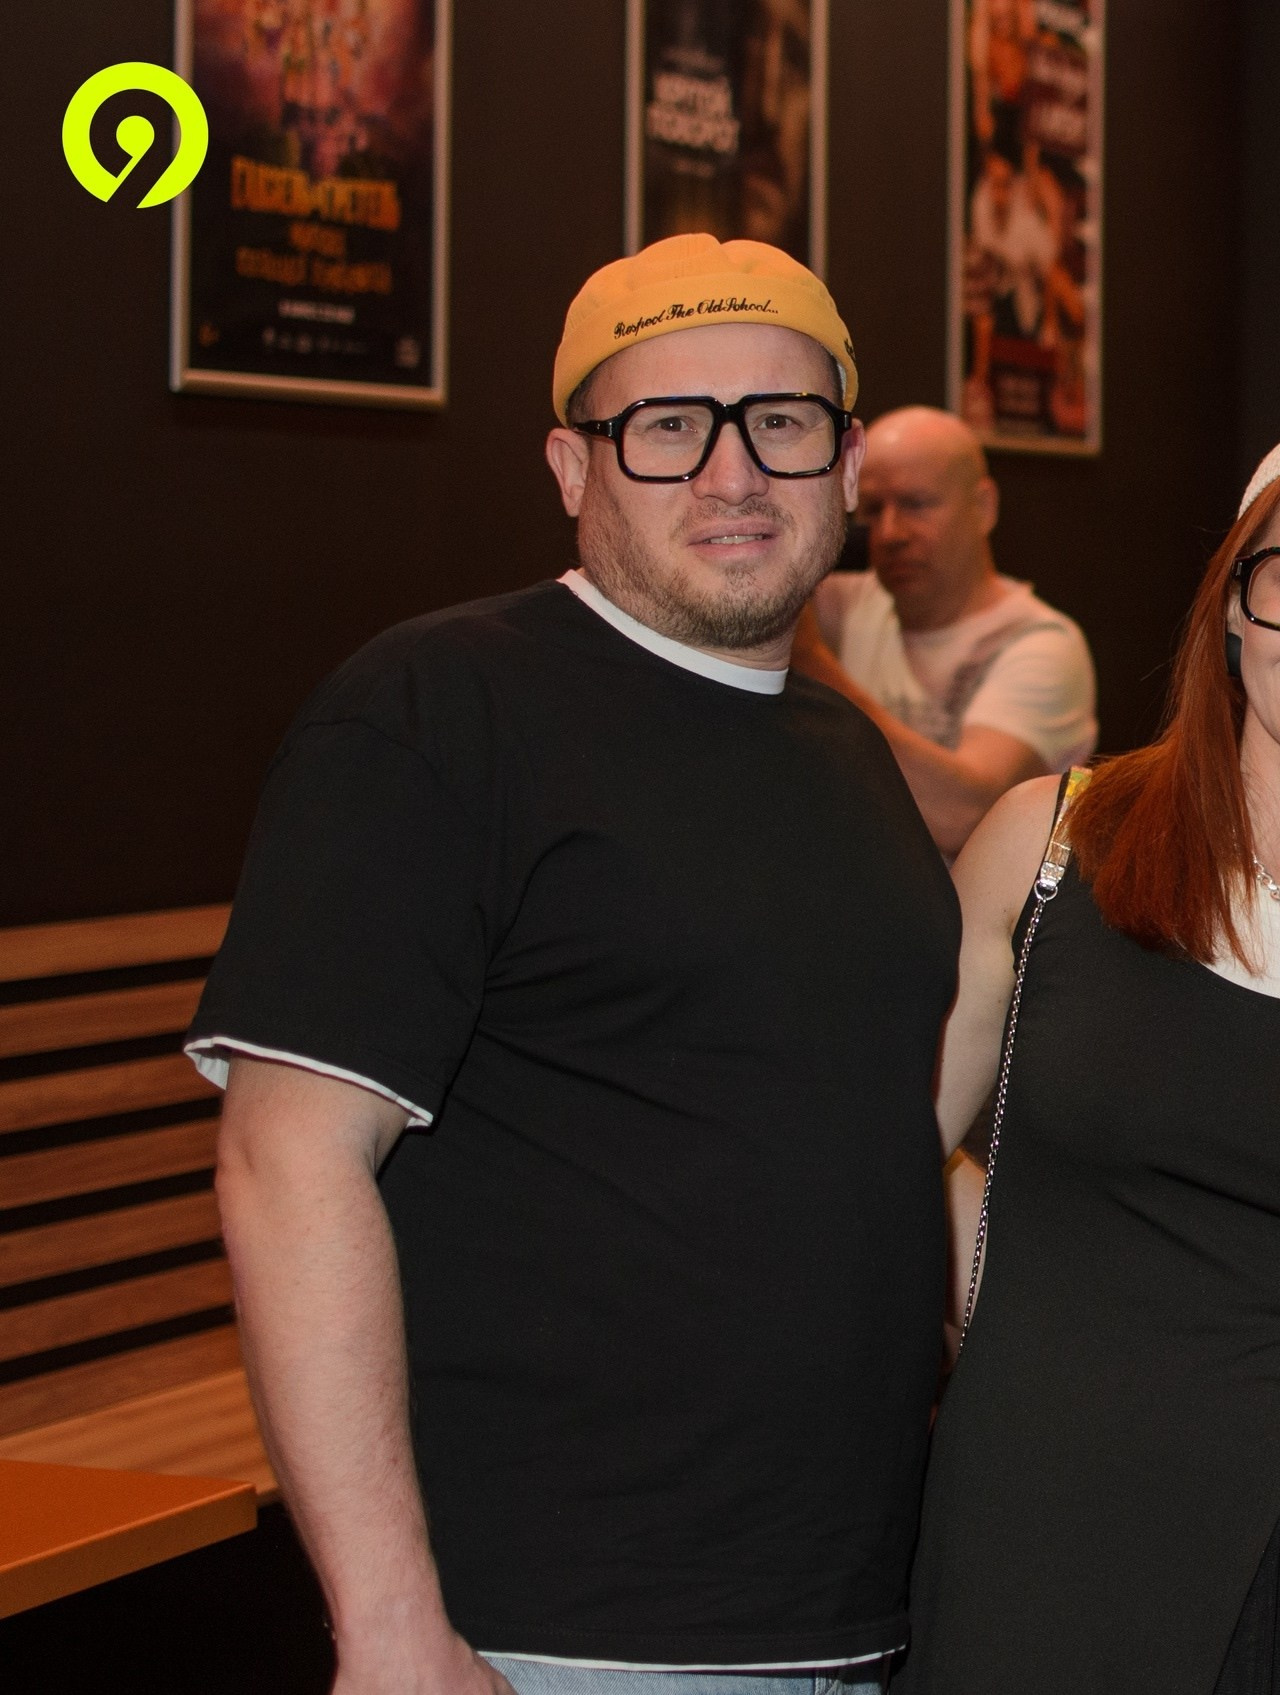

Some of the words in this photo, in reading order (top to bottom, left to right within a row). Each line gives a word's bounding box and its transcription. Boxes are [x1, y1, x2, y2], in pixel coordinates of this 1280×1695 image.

[614, 310, 666, 338] Respect
[666, 304, 695, 321] The
[697, 299, 725, 315] Old
